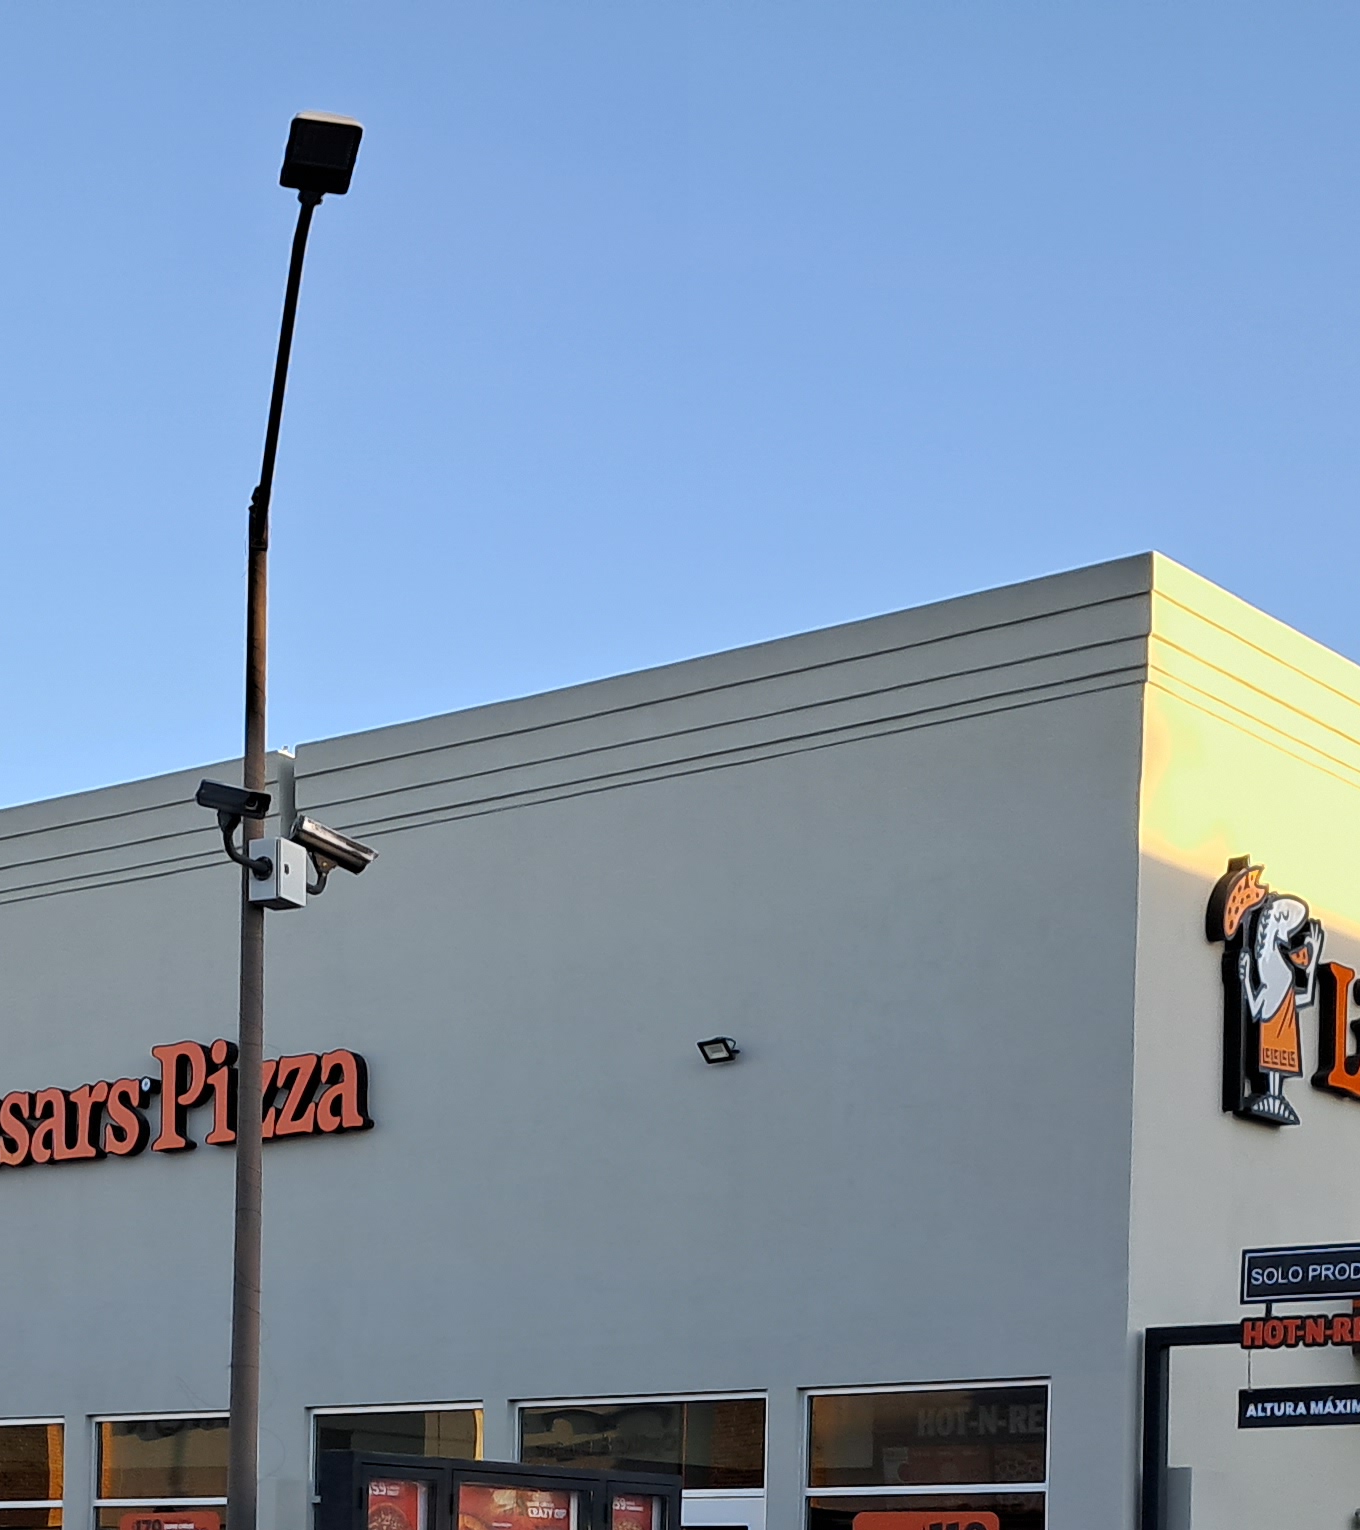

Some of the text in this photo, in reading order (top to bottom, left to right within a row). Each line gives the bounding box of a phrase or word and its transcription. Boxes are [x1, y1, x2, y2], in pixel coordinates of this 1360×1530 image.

[1251, 1265, 1303, 1285] SOLO
[1245, 1401, 1307, 1419] ALTURA
[917, 1404, 1045, 1437] HOT-N-RE
